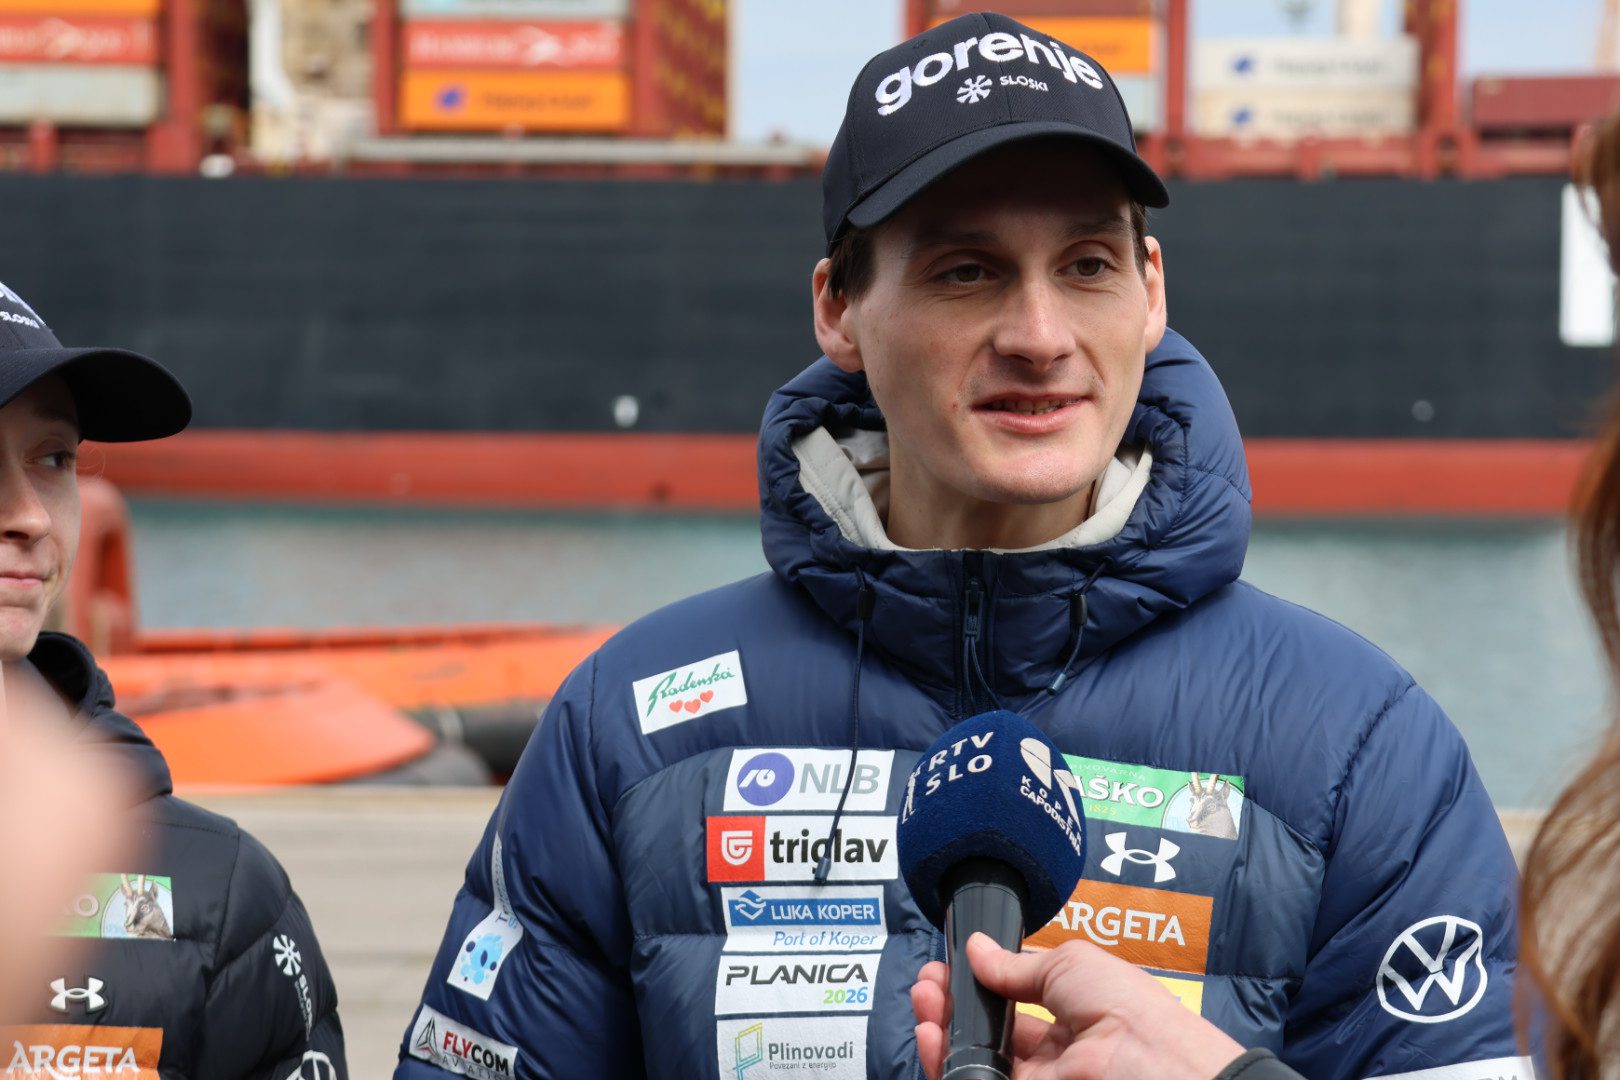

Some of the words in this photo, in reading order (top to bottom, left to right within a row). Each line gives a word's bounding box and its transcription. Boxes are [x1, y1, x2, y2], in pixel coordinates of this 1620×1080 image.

[875, 32, 1103, 116] gorenje
[1000, 75, 1049, 92] SLOSKI
[928, 732, 994, 771] RTV
[799, 763, 881, 794] NLB
[925, 754, 993, 796] SLO
[771, 904, 814, 921] LUKA
[818, 904, 875, 920] KOPER
[773, 931, 804, 947] Port
[809, 931, 827, 945] of
[829, 931, 878, 950] Koper
[725, 963, 869, 986] PLANICA
[823, 986, 869, 1004] 2026
[6, 1040, 140, 1080] ARGETA
[443, 1030, 509, 1077] FLYCOM
[768, 1041, 853, 1061] Plinovodi
